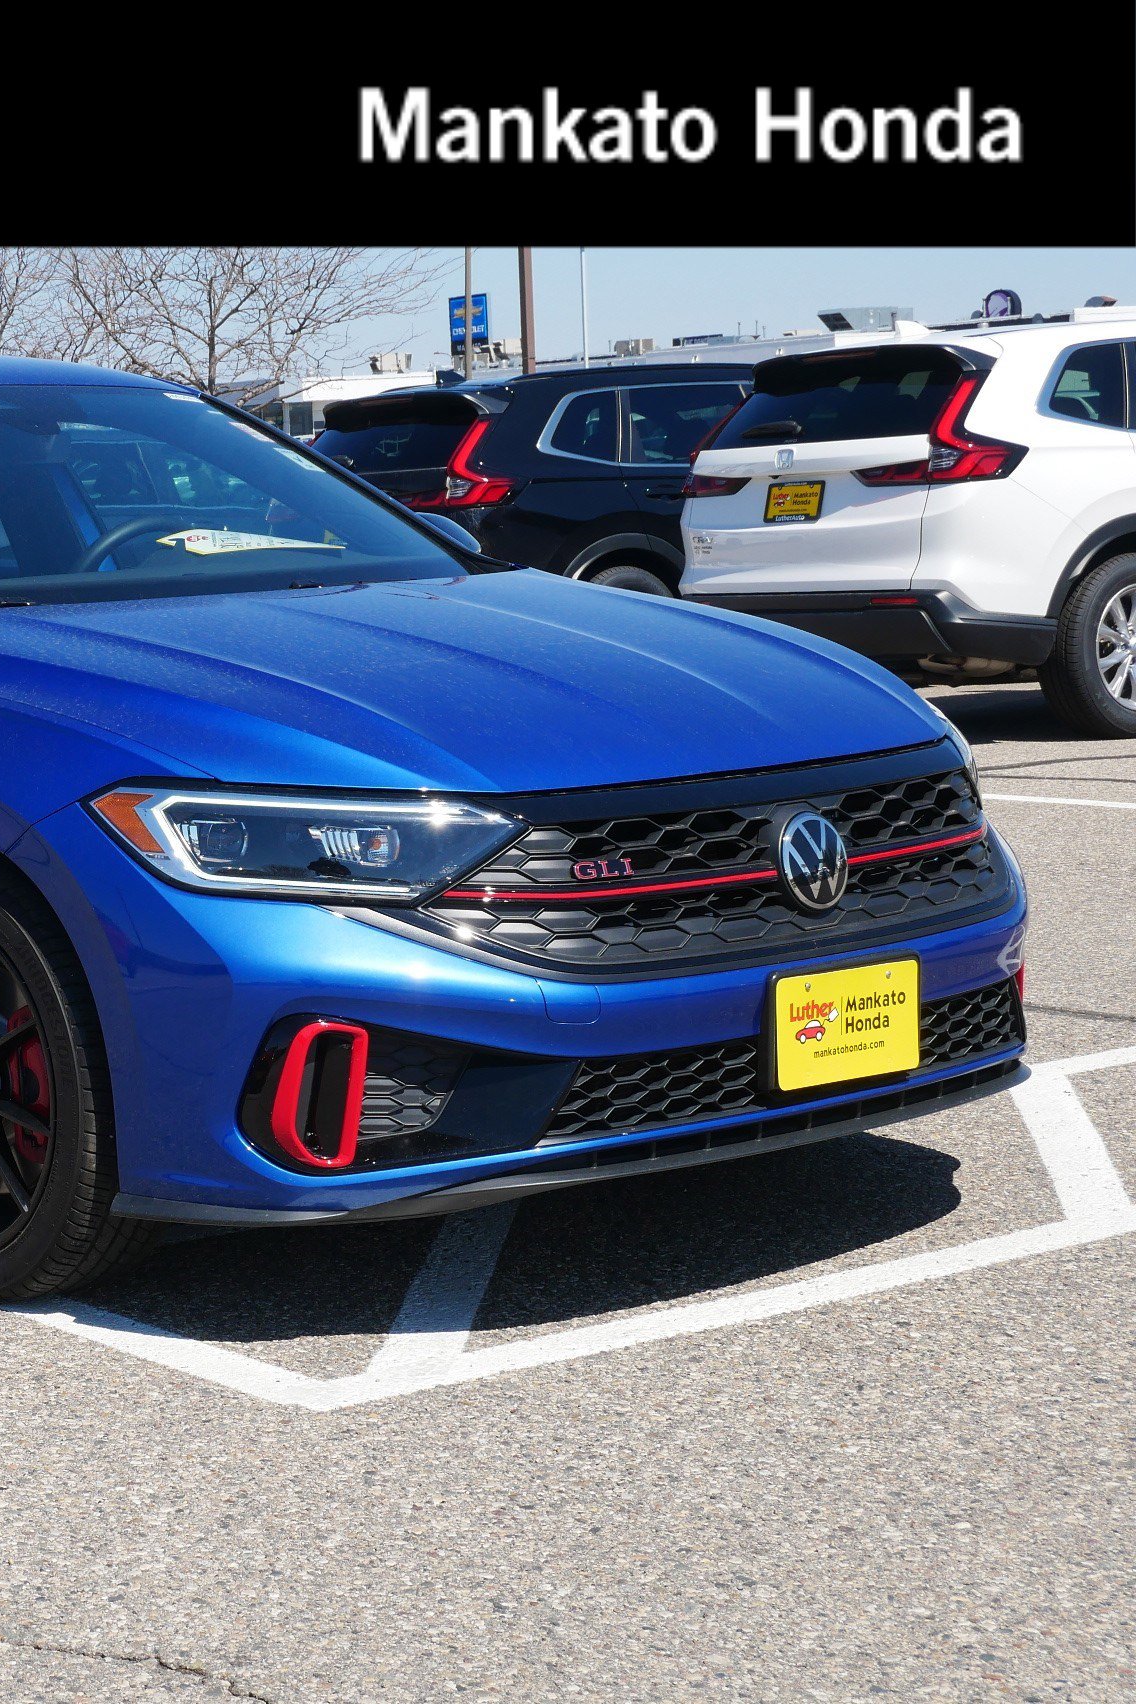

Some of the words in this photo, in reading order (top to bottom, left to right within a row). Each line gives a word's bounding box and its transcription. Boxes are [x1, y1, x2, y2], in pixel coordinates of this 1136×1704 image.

[452, 325, 485, 336] CHEVOLET
[772, 492, 791, 501] Luther
[793, 491, 819, 499] Mankato
[572, 857, 635, 881] GLI
[789, 999, 835, 1023] Luther
[845, 990, 906, 1013] Mankato
[845, 1012, 890, 1034] Honda
[813, 1039, 885, 1059] mankatohonda.com
